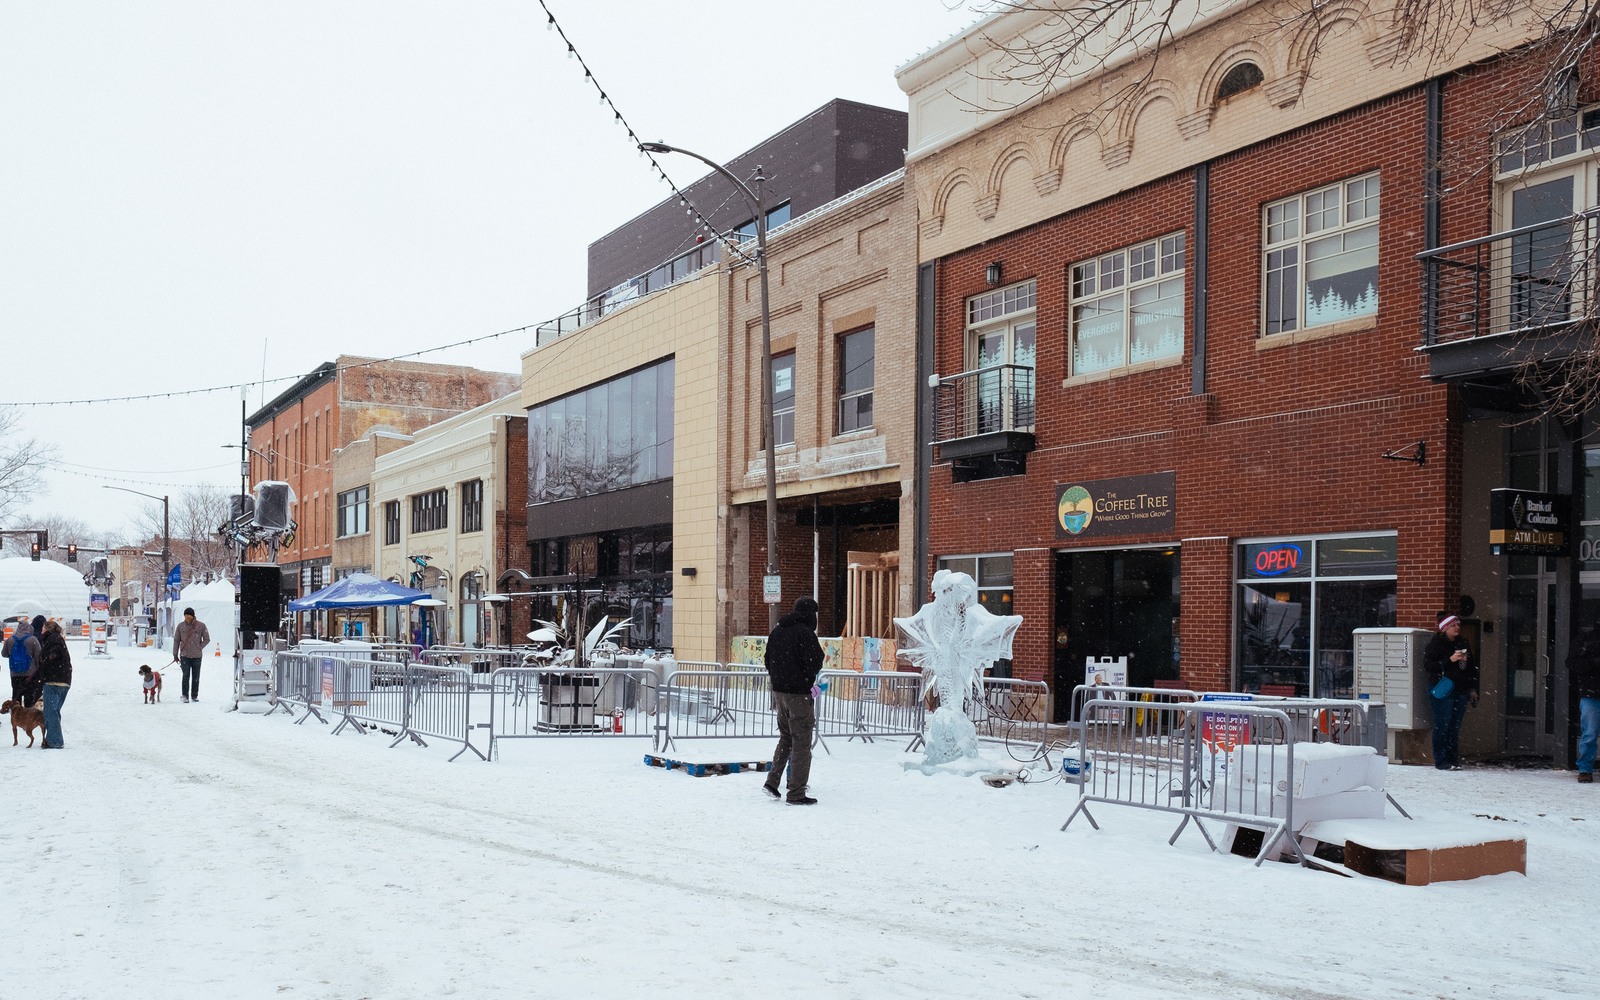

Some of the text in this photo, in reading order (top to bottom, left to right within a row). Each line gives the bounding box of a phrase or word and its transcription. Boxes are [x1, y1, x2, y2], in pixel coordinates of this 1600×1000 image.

[1078, 306, 1181, 340] EVERGREEN INDUSTRIAL
[1095, 494, 1169, 513] COFFEE TREE
[1526, 499, 1553, 512] Bank of
[1115, 513, 1130, 521] GOOD
[1527, 512, 1558, 525] Colorado
[1514, 532, 1554, 544] ATM LIVE
[1255, 549, 1298, 571] OPEN
[1216, 716, 1248, 724] SCUPTNG
